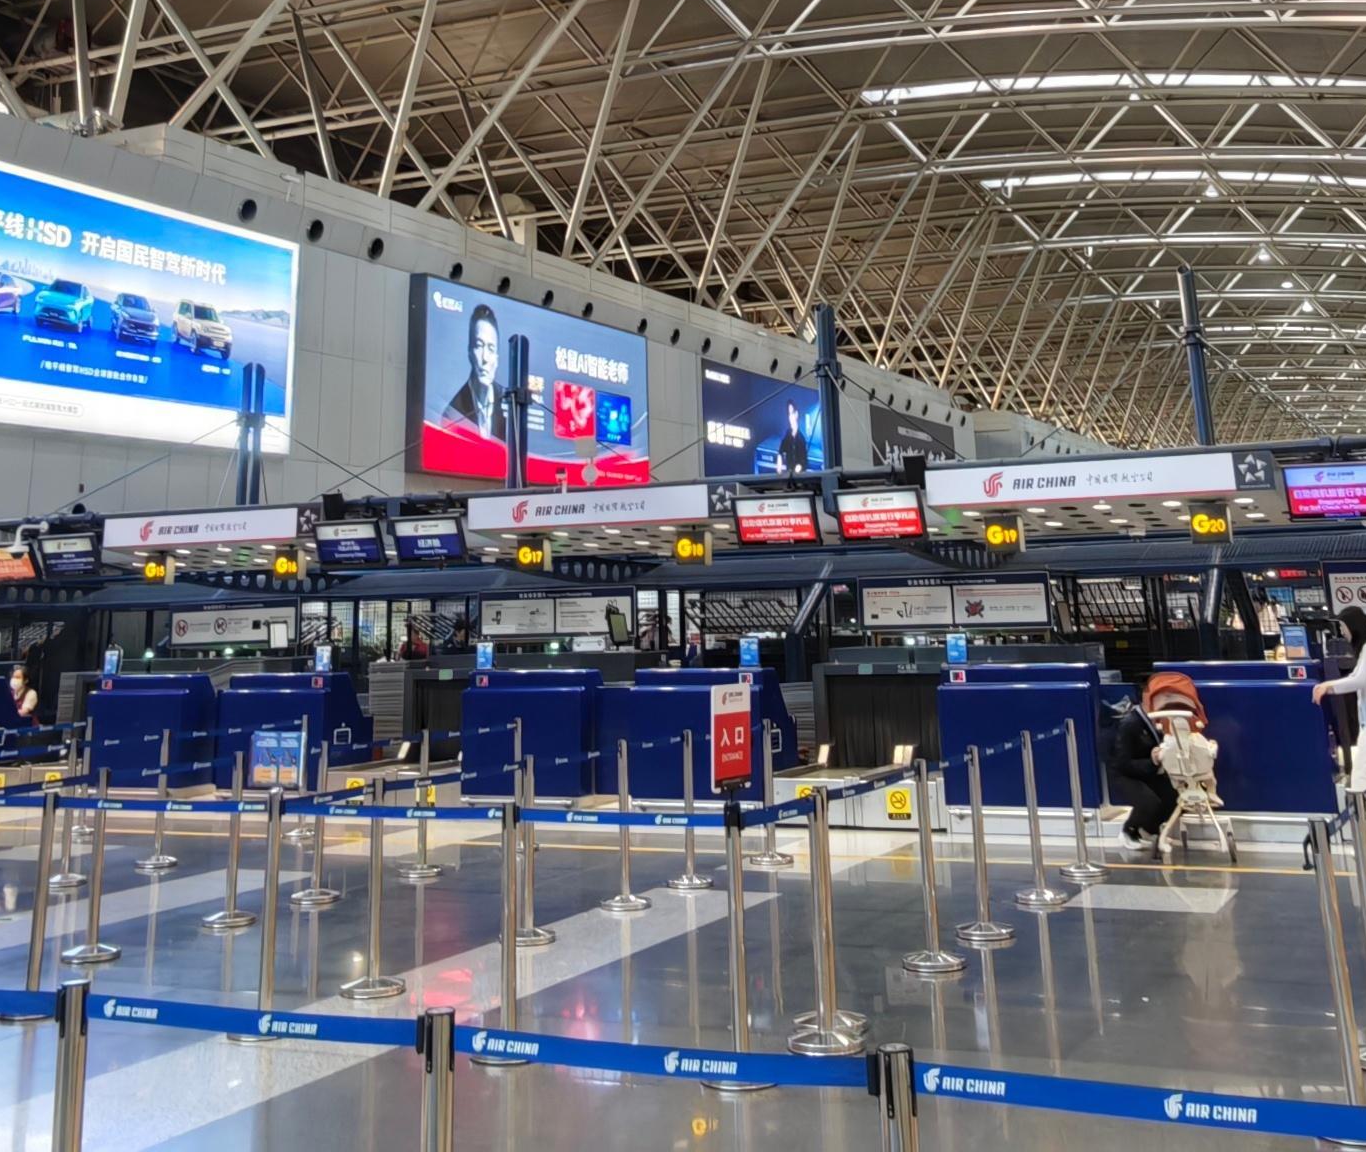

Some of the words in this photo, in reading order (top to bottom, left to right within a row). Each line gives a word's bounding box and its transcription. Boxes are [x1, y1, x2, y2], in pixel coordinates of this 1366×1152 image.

[80, 230, 227, 287] 开启国民智驾新时代
[555, 346, 629, 384] 松鼠Ai智能老师
[1012, 478, 1034, 490] AIR
[1037, 475, 1076, 489] CHINA
[535, 506, 552, 517] AIR
[554, 503, 586, 516] CHINA
[1191, 513, 1227, 534] G20
[986, 525, 1017, 545] G19
[518, 546, 543, 565] G17
[677, 538, 704, 558] G18
[720, 726, 744, 747] 入口
[271, 1021, 286, 1033] AIR
[288, 1022, 319, 1035] CHINA
[487, 1038, 505, 1053] AIR
[506, 1040, 539, 1056] CHINA
[680, 1059, 700, 1072] AIR
[702, 1059, 737, 1074] CHINA
[942, 1075, 964, 1091] AIR
[966, 1078, 1006, 1096] CHINA
[1185, 1102, 1210, 1119] AIR
[1212, 1105, 1257, 1124] CHINA
